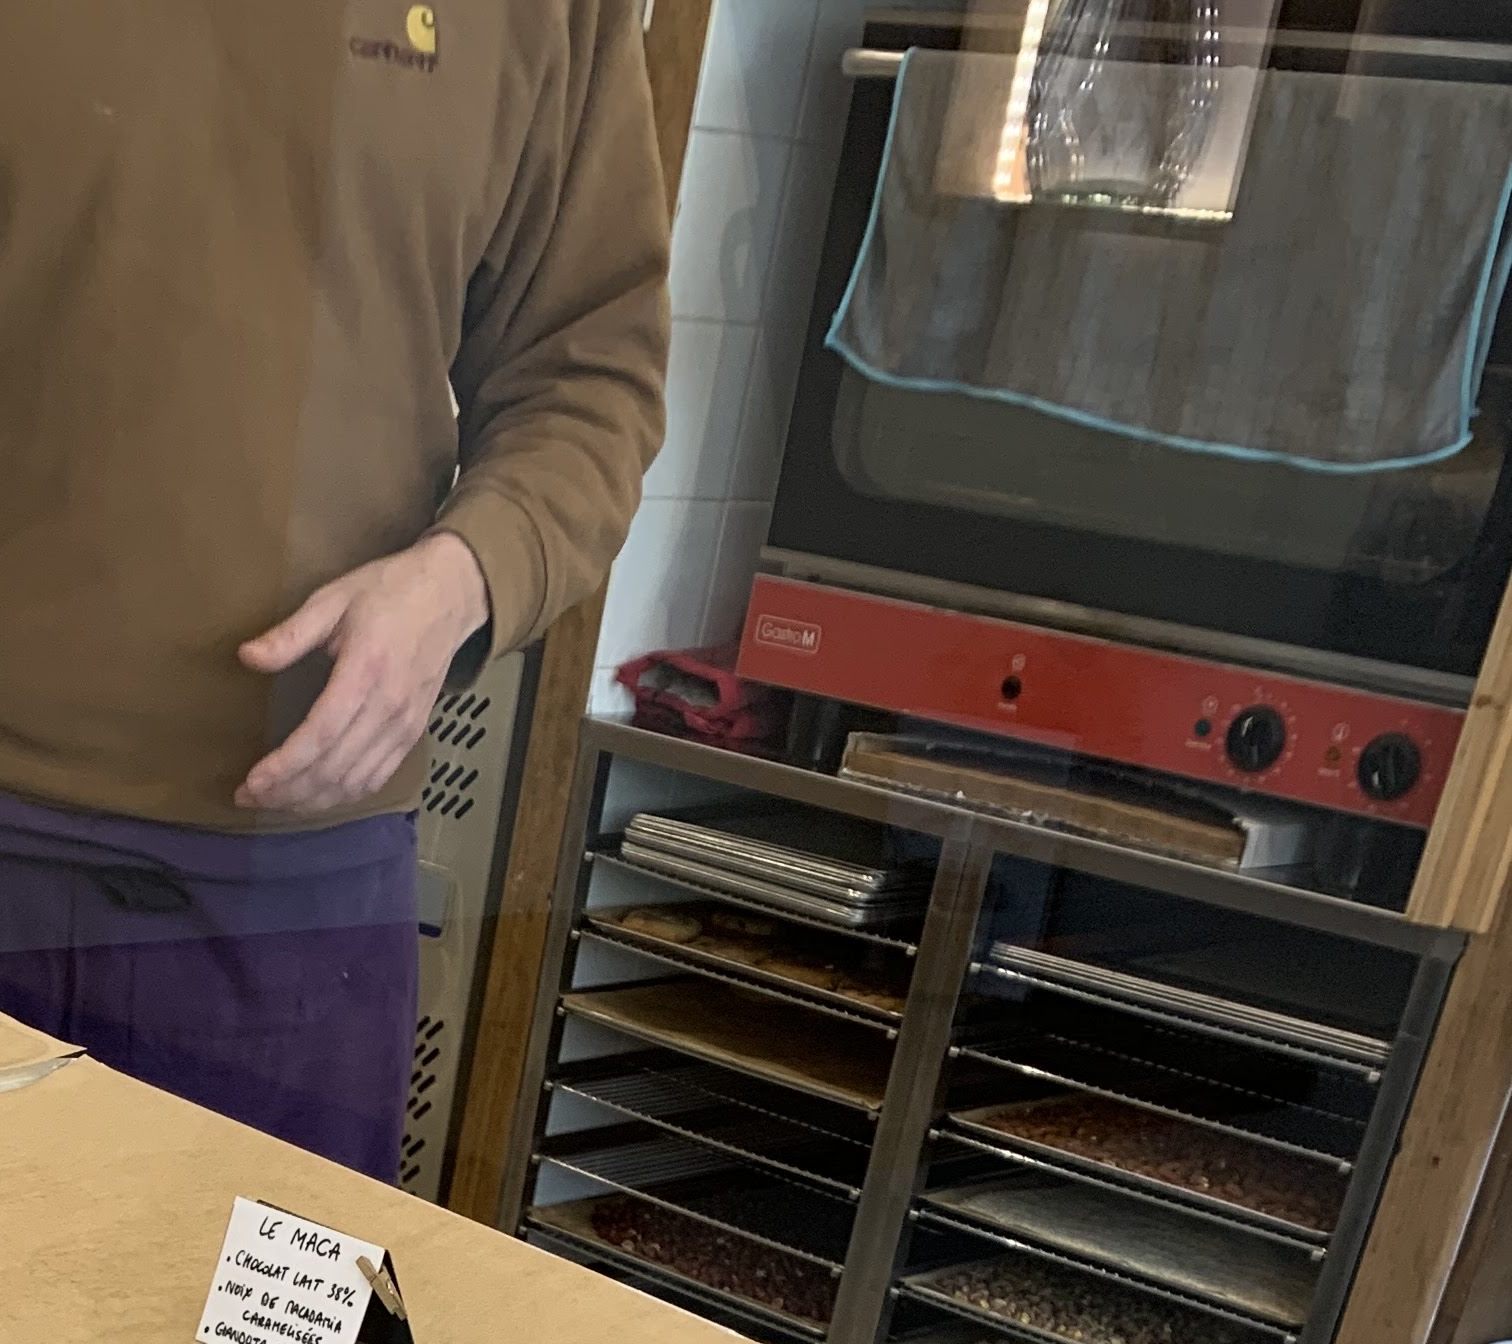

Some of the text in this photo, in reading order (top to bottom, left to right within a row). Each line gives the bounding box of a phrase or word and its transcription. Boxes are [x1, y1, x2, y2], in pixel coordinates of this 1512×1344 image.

[260, 1216, 341, 1261] LE MACA
[235, 1250, 356, 1307] CHOCOLAT LAIT 38%
[225, 1280, 341, 1334] NOIX DE MACADAMIA
